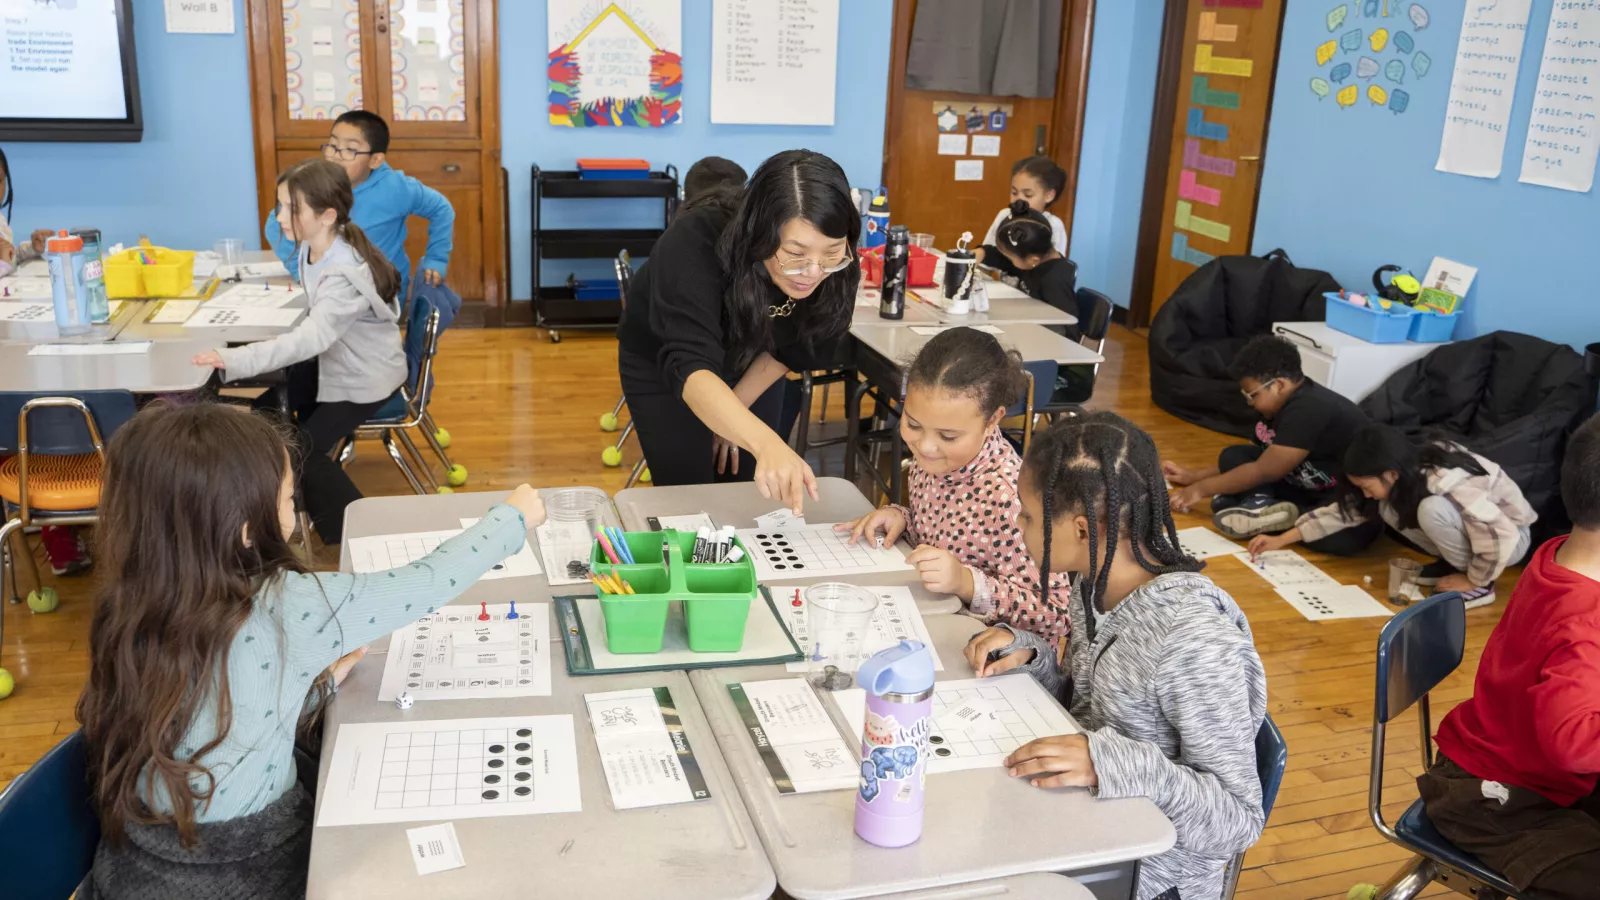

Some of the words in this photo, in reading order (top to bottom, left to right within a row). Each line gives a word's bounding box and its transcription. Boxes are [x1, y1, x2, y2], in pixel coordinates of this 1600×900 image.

[180, 2, 207, 12] Wall
[210, 2, 218, 13] B
[1556, 19, 1579, 30] bold
[1465, 36, 1499, 47] conveys
[1545, 73, 1588, 85] obstacle
[1542, 90, 1593, 101] optimism
[1538, 107, 1595, 120] pessimism
[1534, 124, 1591, 138] resourceful
[1532, 139, 1580, 154] tenacious
[750, 727, 769, 748] Hayzel
